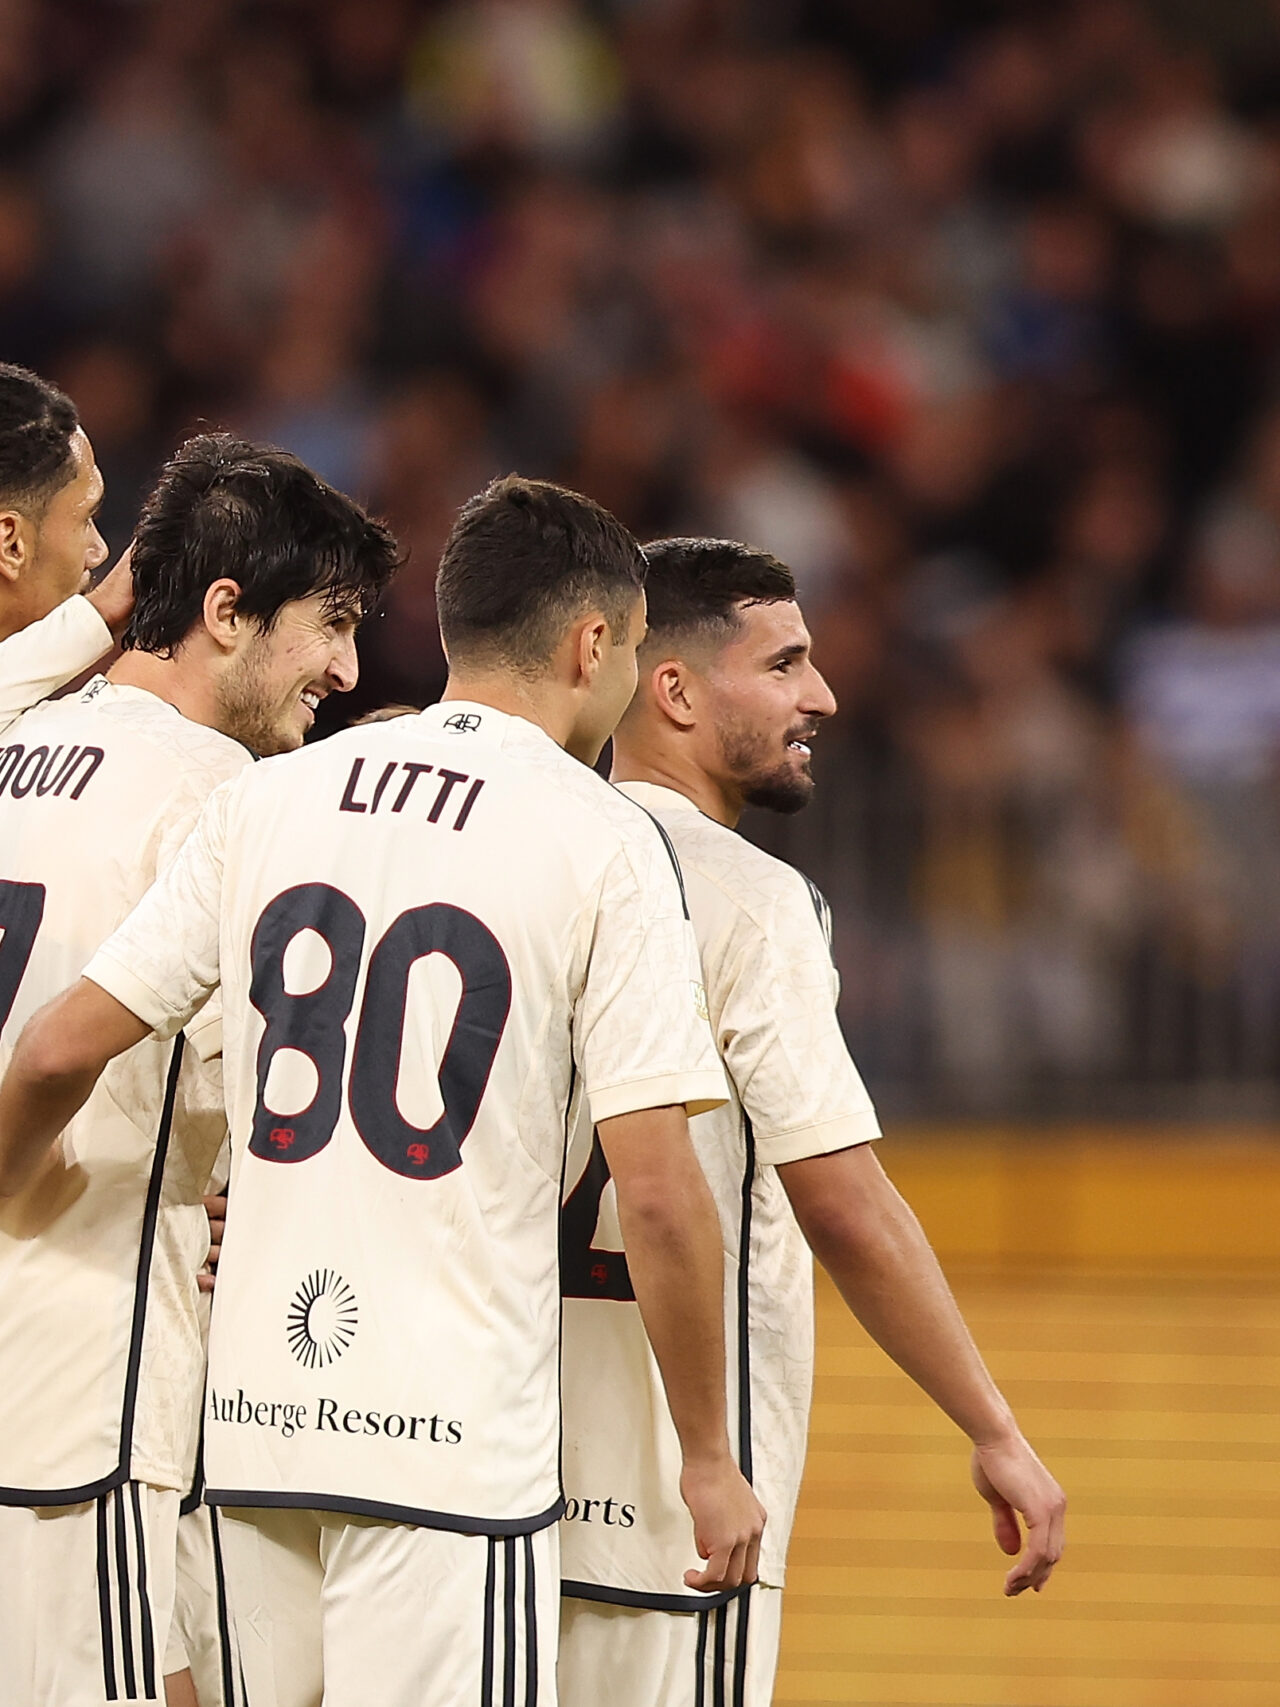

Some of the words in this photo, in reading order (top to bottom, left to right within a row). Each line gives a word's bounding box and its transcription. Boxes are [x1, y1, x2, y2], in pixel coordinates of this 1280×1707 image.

[339, 757, 485, 831] LITTI
[248, 882, 512, 1181] 80
[315, 1398, 463, 1445] Resorts
[564, 1496, 636, 1528] orts
